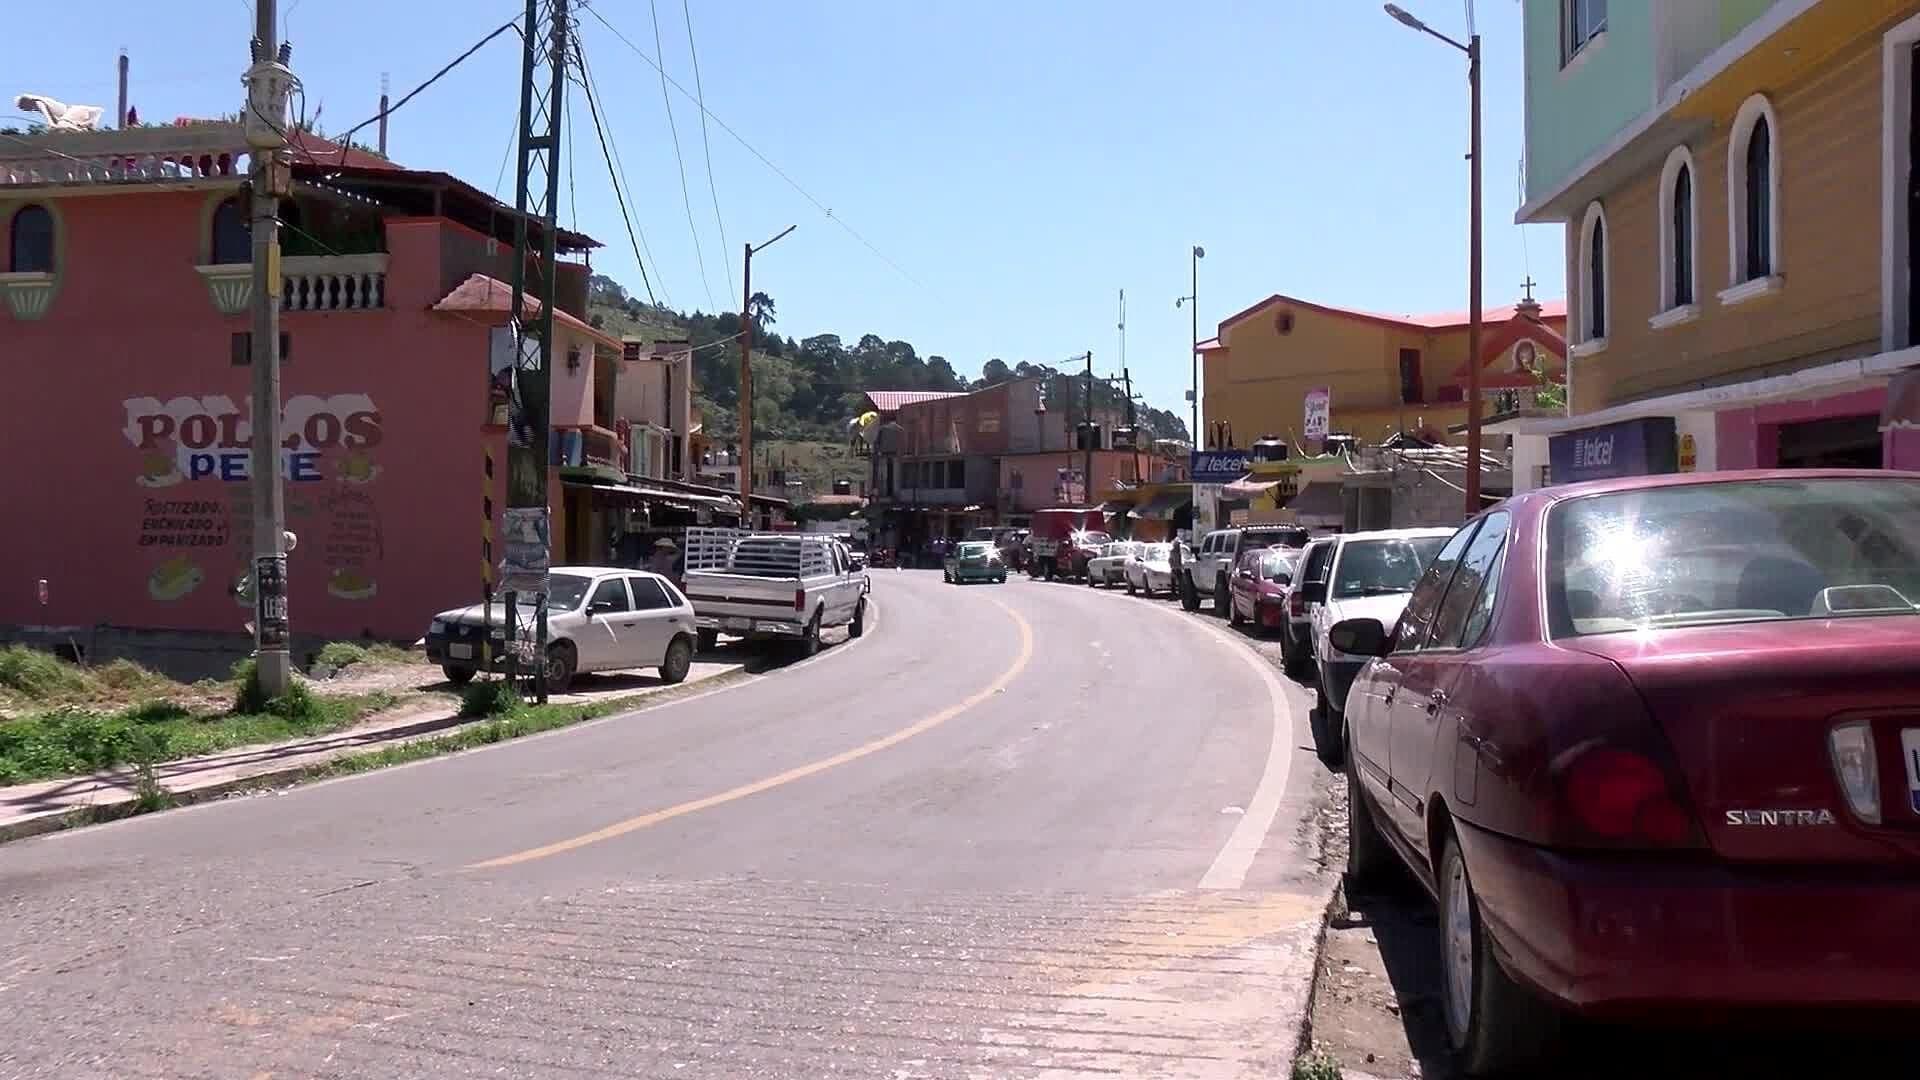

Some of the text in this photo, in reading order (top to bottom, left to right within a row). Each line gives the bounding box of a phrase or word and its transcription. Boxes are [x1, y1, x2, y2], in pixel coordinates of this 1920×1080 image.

[1584, 434, 1614, 467] telcel
[189, 453, 324, 482] PEE
[1725, 808, 1837, 825] SENTRA
